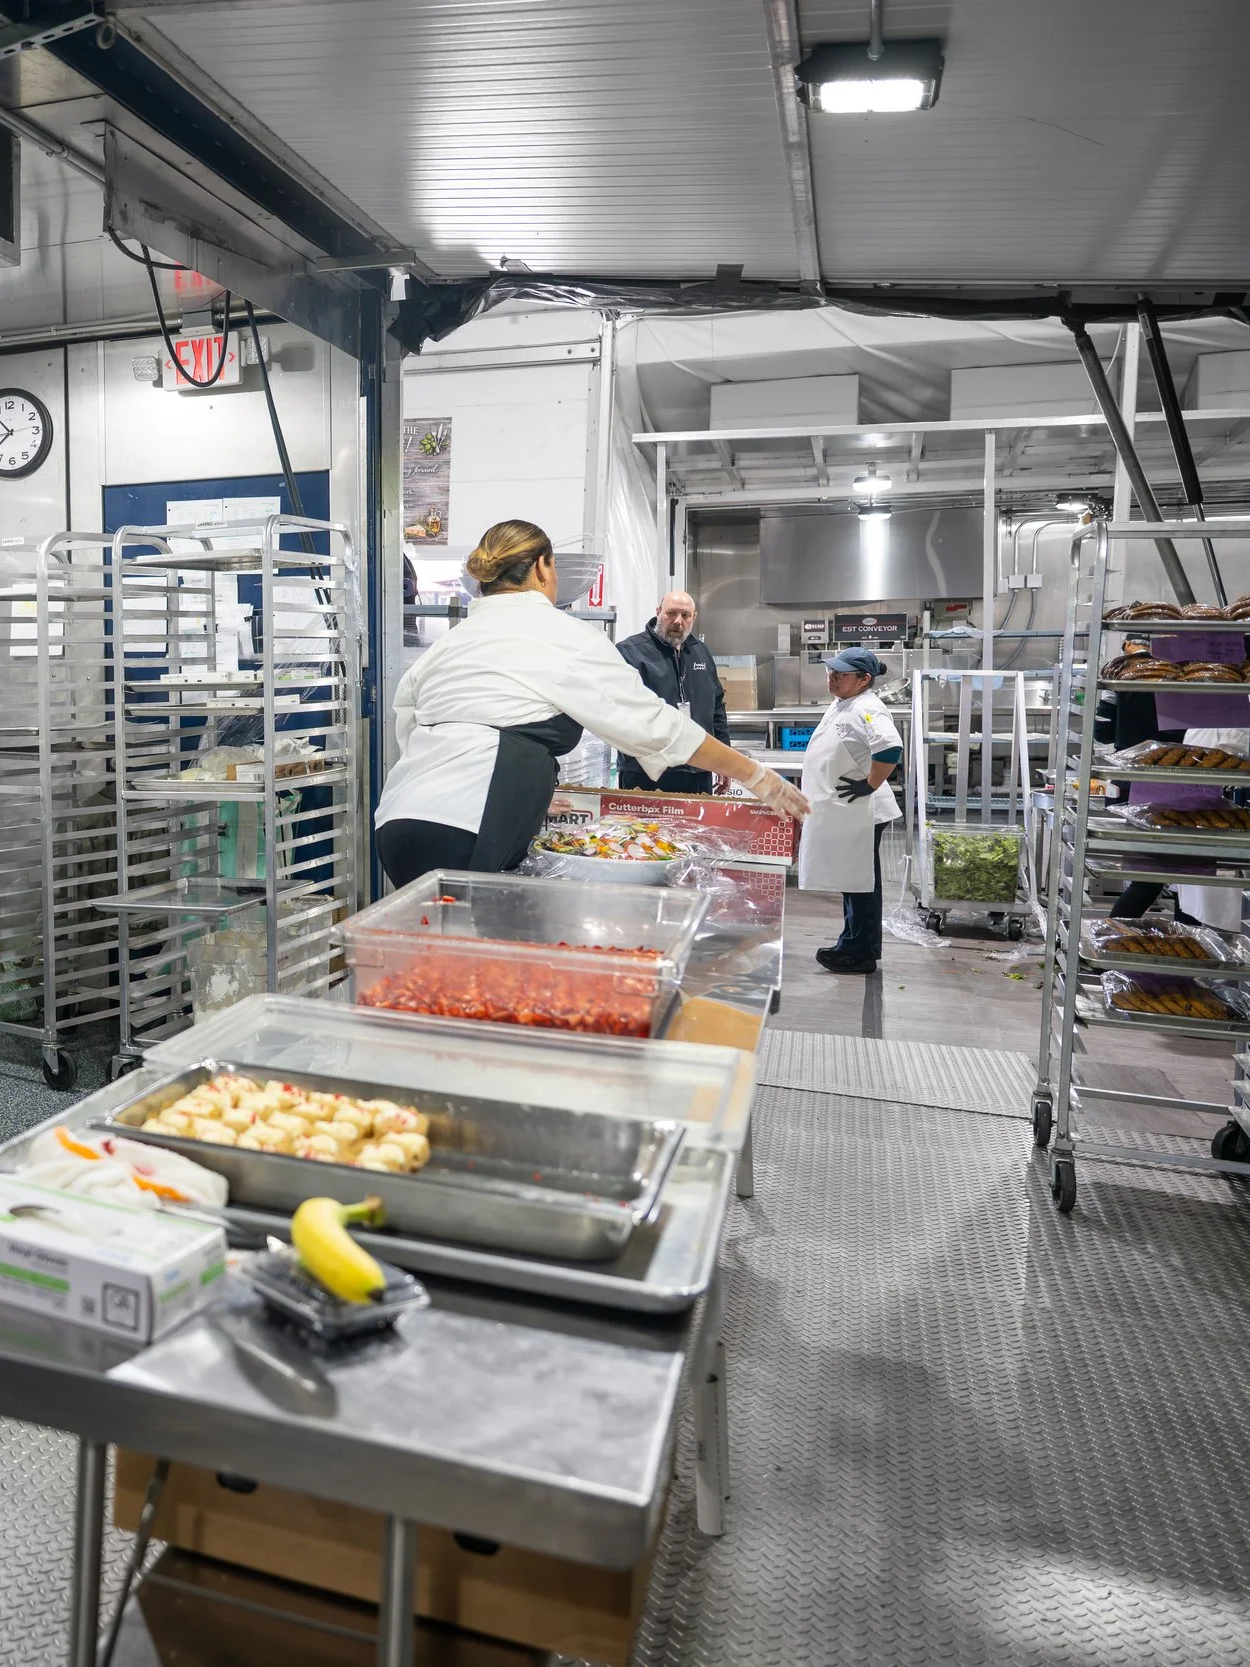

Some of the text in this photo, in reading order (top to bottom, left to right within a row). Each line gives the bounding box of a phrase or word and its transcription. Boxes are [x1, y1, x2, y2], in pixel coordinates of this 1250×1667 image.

[175, 336, 225, 385] EXIT
[5, 401, 14, 409] 12
[28, 412, 36, 420] 2
[32, 426, 40, 434] 3
[30, 440, 37, 448] 4
[22, 452, 29, 460] 5
[9, 457, 16, 465] 6
[608, 802, 684, 815] Cutterbox Film
